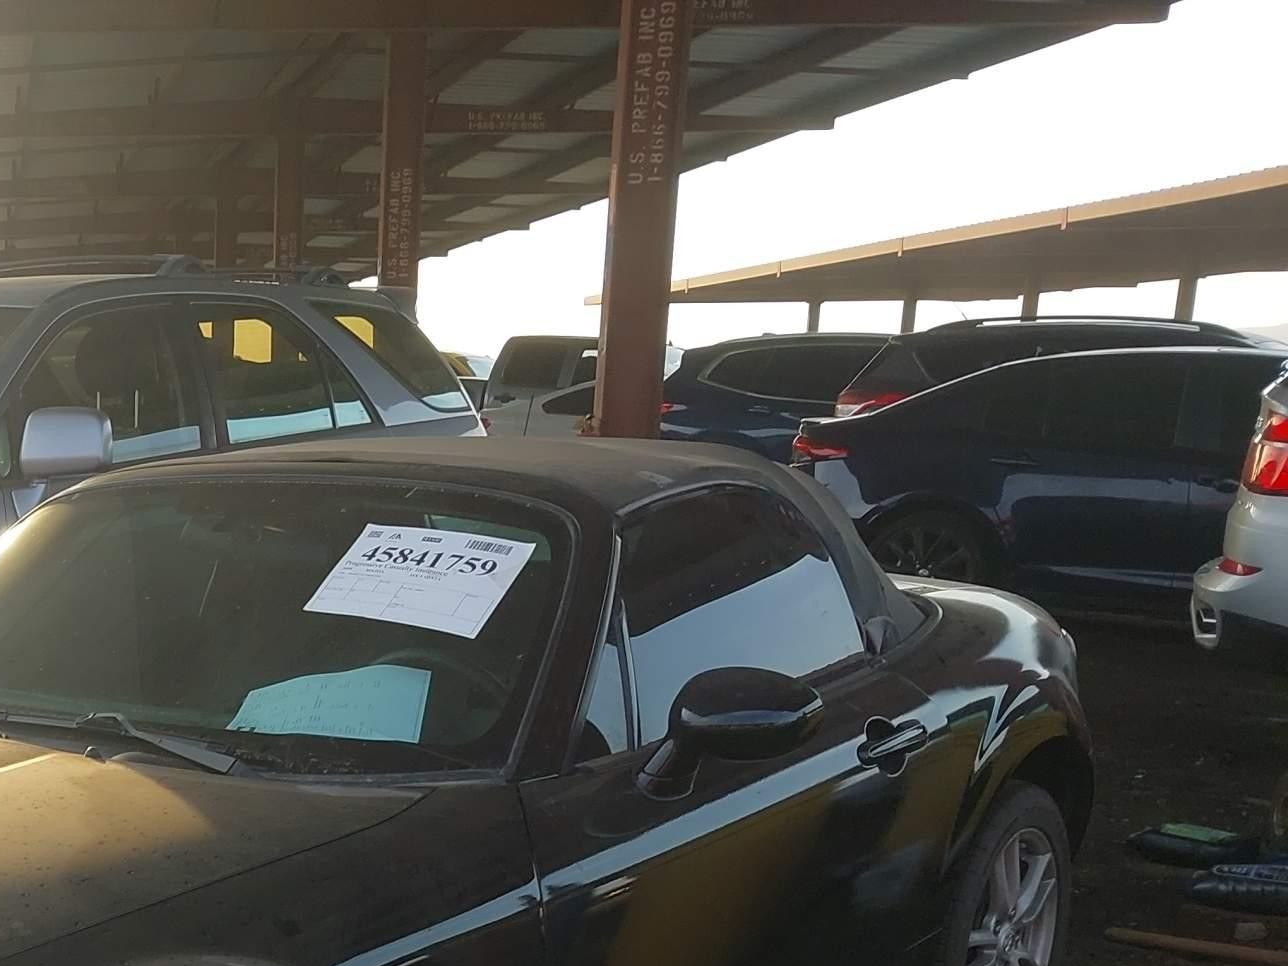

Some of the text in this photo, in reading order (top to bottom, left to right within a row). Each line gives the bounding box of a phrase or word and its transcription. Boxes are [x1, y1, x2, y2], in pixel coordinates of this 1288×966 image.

[627, 8, 656, 184] U.S. PREFAB INC
[647, 1, 676, 182] 1-866-799-0969
[361, 545, 498, 577] 45841759
